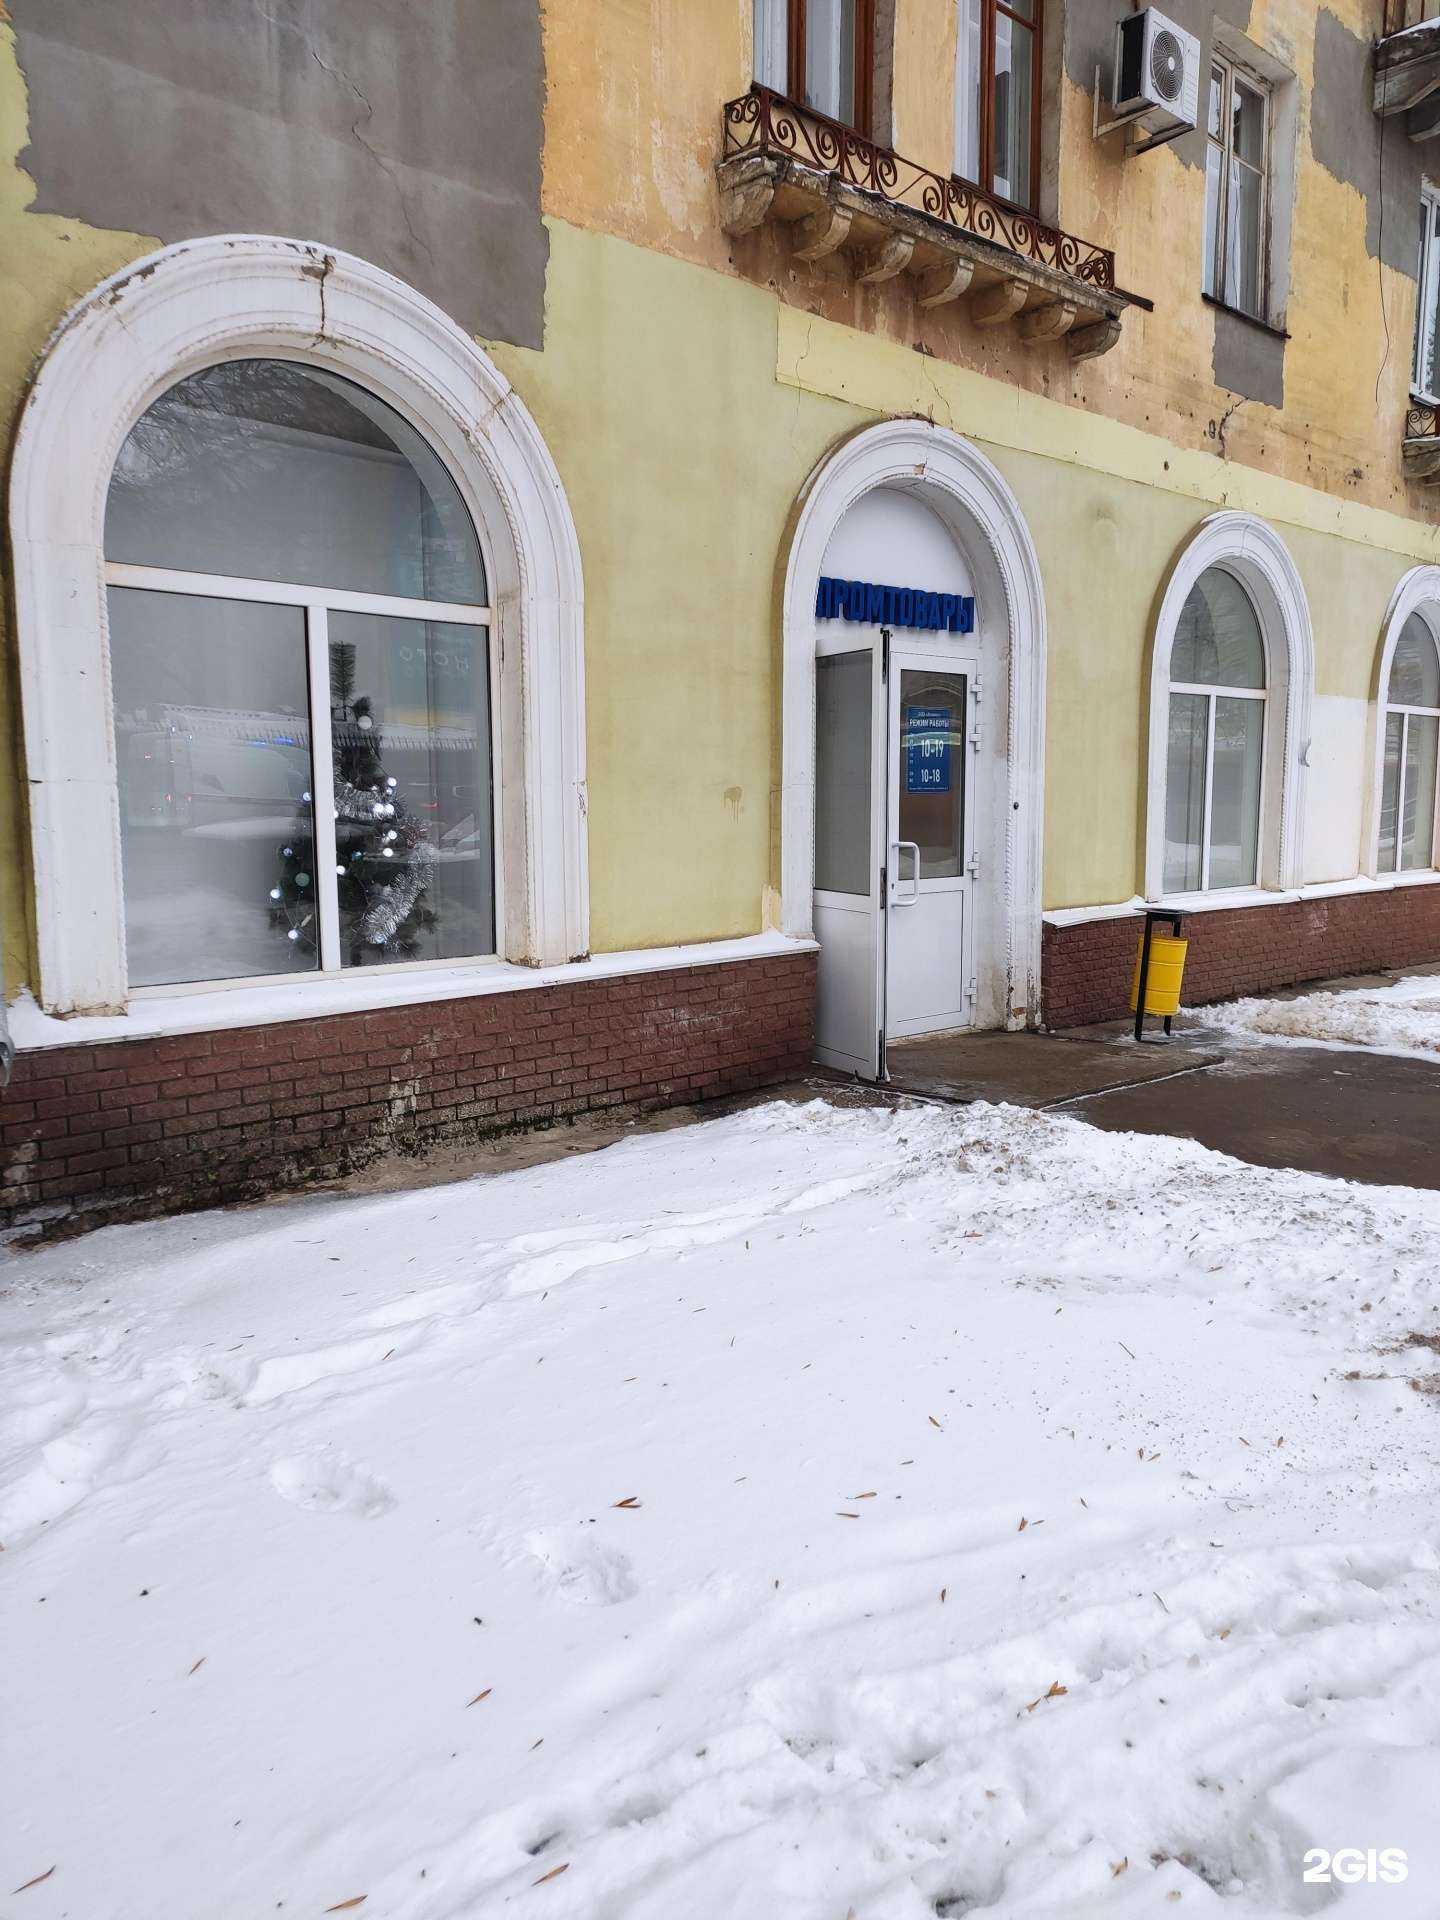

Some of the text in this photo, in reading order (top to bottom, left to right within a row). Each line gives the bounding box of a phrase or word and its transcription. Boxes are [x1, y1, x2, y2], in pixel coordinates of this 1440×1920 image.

[815, 576, 975, 633] ПРОМТОВАРЫ
[909, 718, 950, 728] РЕЖИМ РАБОТЫ
[920, 738, 944, 758] 10-19
[920, 768, 941, 783] 10-18
